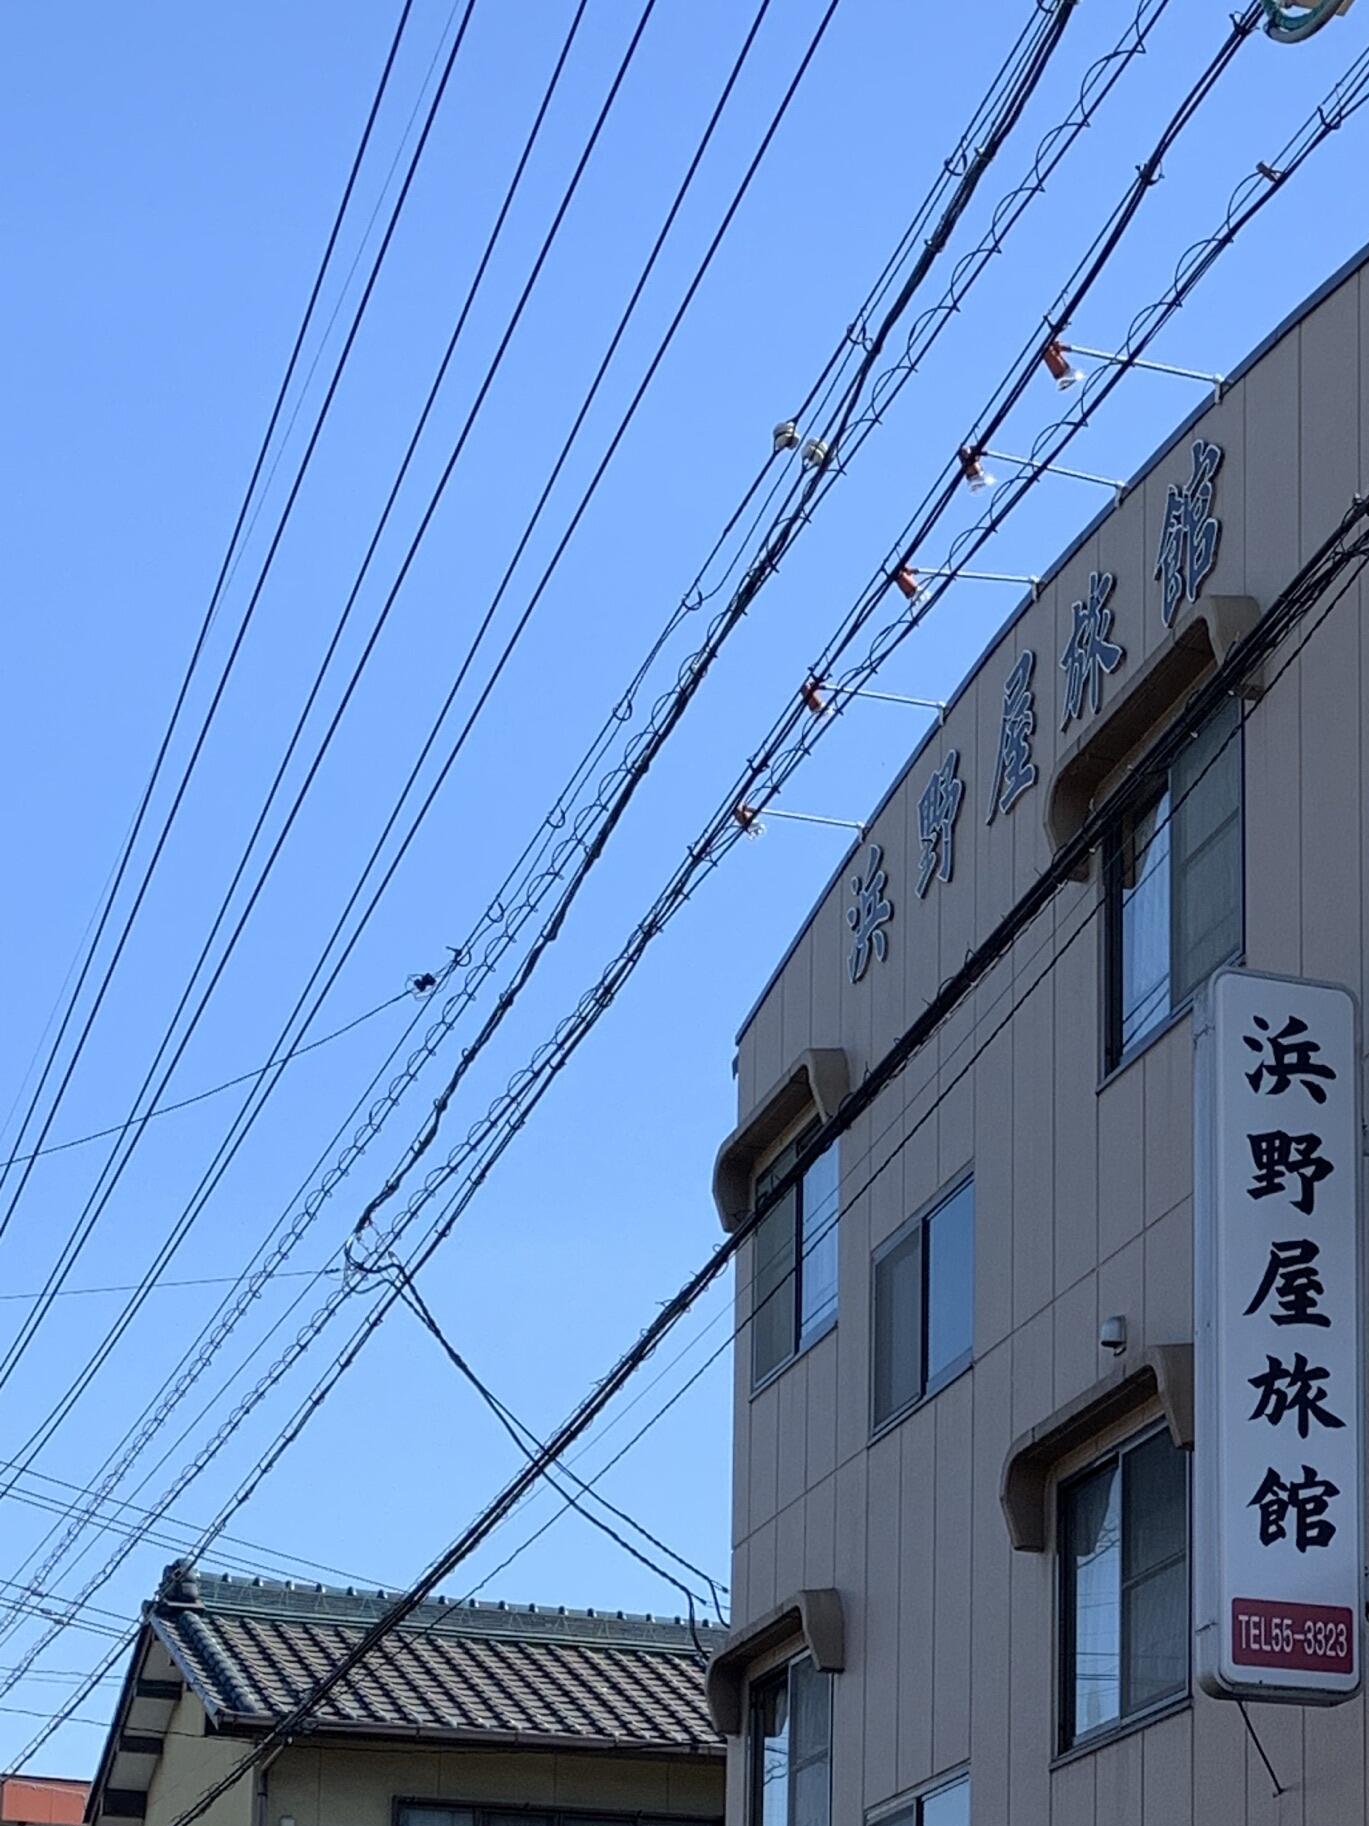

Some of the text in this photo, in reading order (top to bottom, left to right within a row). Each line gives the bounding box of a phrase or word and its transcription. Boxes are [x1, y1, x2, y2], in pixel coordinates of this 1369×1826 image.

[848, 440, 1224, 984] 浜野屋旅館
[1242, 1014, 1346, 1553] 浜野屋旅館
